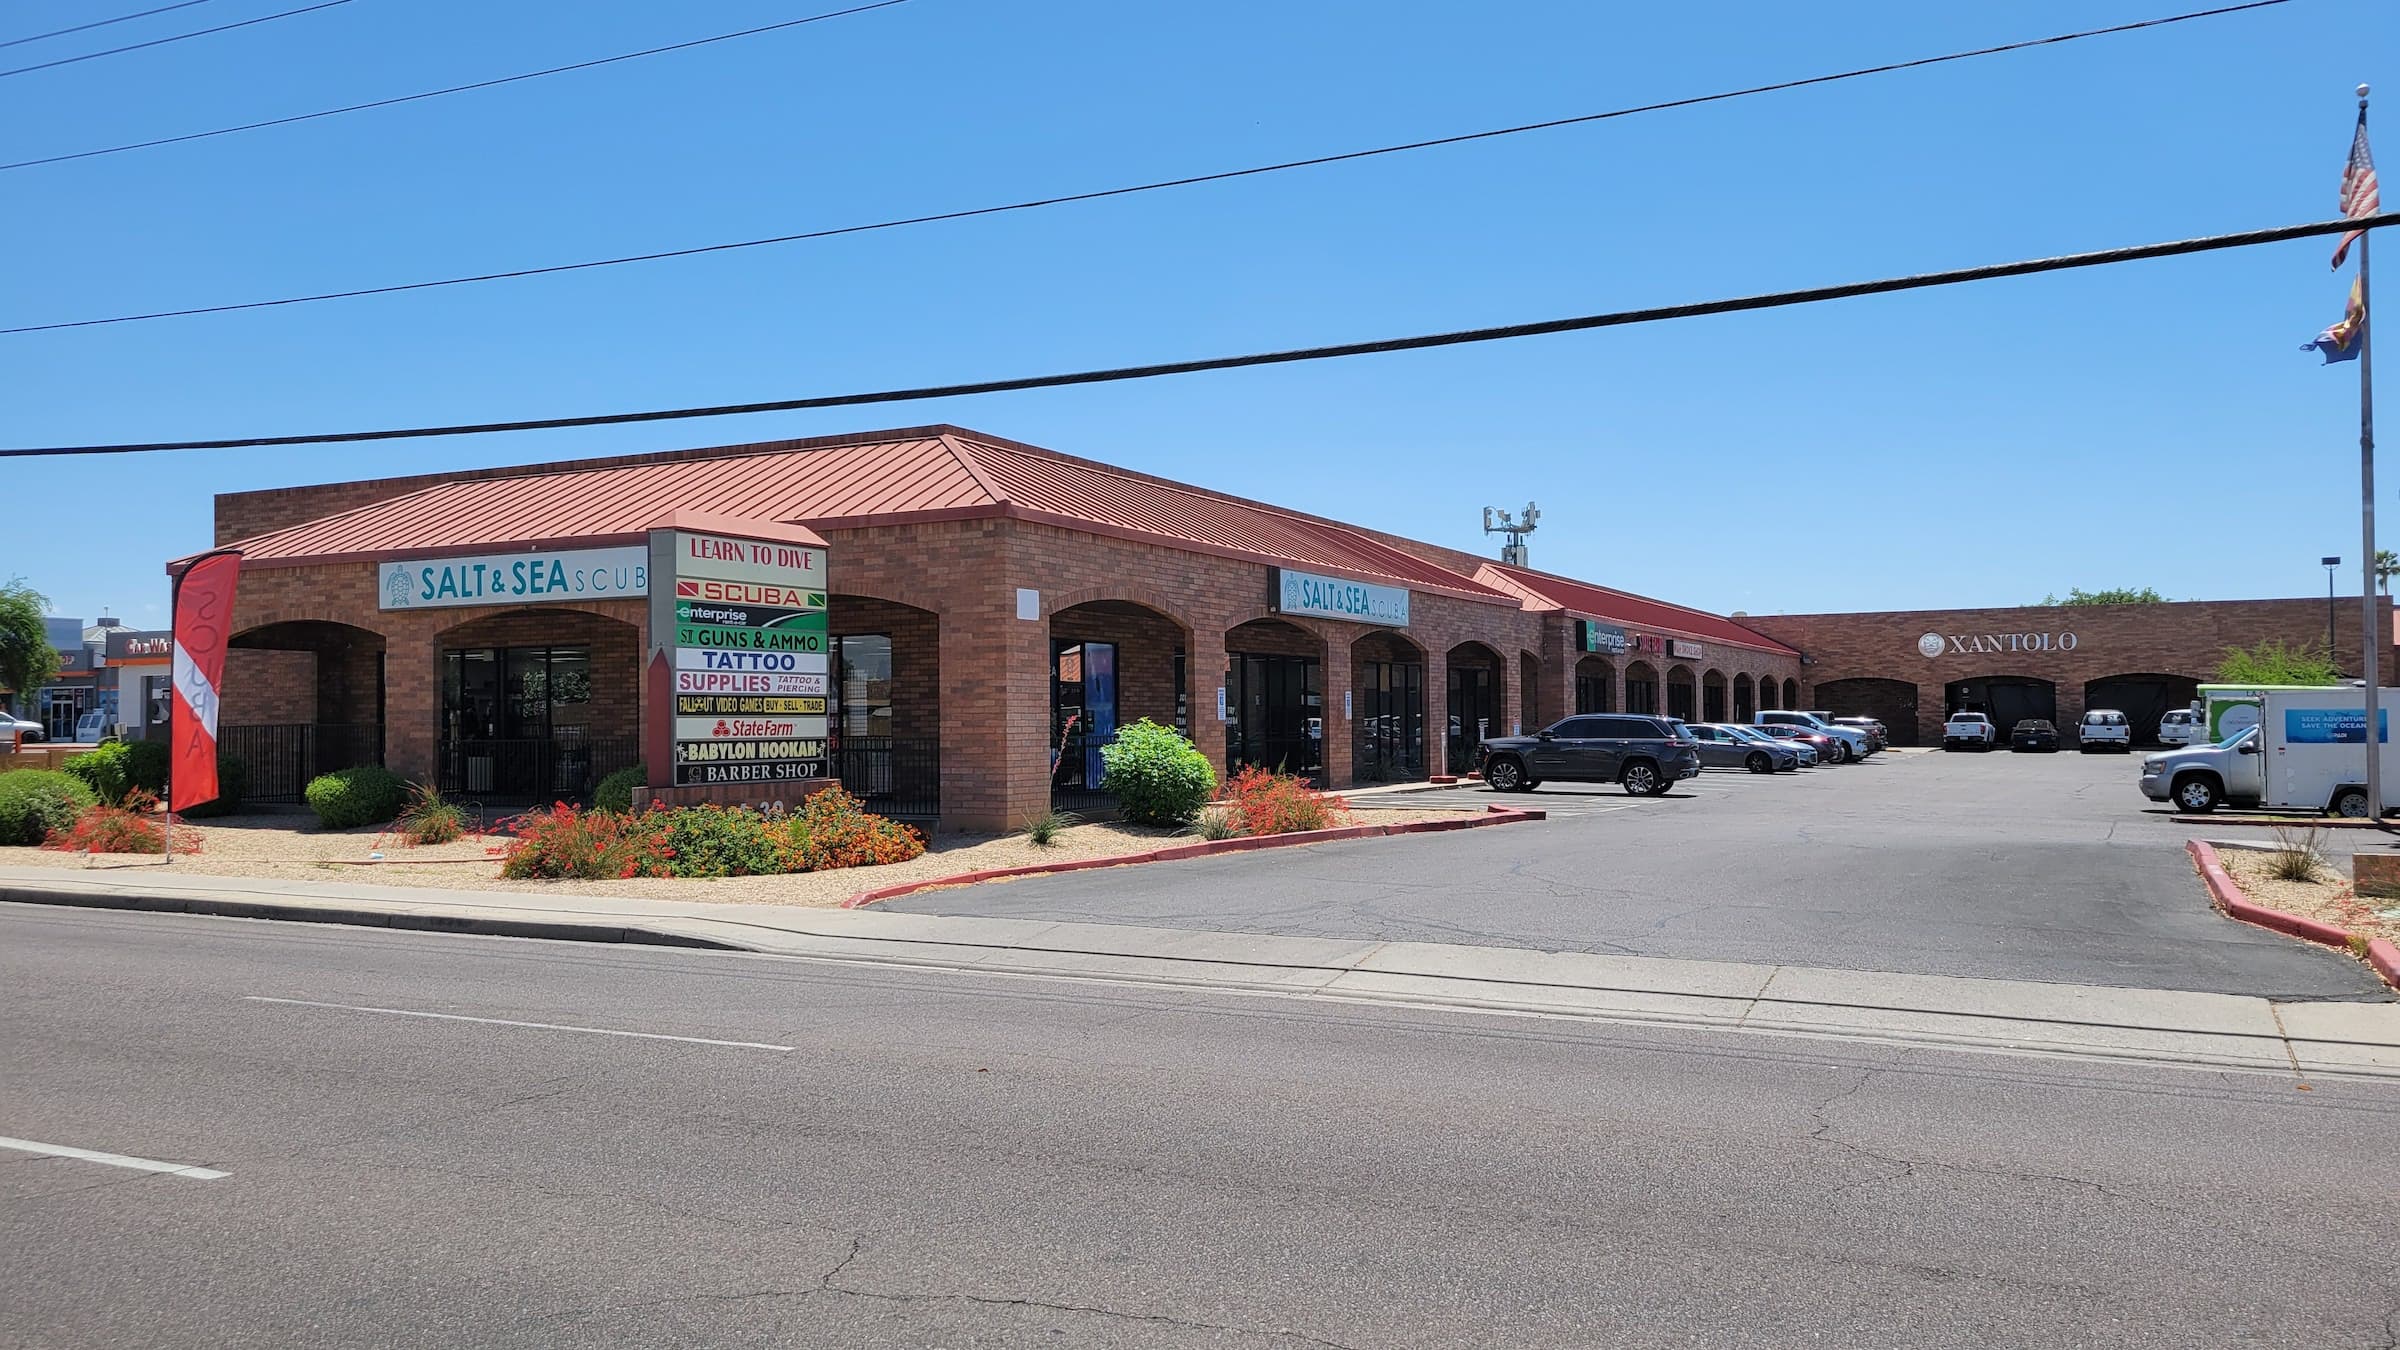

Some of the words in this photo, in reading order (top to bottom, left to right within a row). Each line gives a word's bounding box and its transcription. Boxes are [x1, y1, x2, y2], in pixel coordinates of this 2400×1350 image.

[691, 538, 745, 562] LEARN
[750, 545, 772, 565] TO
[778, 548, 813, 570] DIVE
[421, 564, 487, 600] SALT
[511, 559, 569, 595] SEA
[704, 582, 802, 606] SCUBA
[1303, 579, 1335, 610] SALT
[1346, 586, 1370, 615] SEA
[1371, 599, 1407, 619] SCUBA
[678, 606, 747, 622] enterprise
[698, 630, 748, 647] GUNS
[753, 631, 765, 648] &
[769, 634, 819, 651] AMMO
[1588, 630, 1625, 649] enterprise
[1949, 632, 2078, 653] XANTOLO
[702, 651, 796, 670] TATTOO
[680, 673, 771, 692] SUPPLIES
[777, 676, 812, 684] TATTOO
[777, 685, 820, 693] PIERCING
[715, 697, 738, 713] VIDEO
[740, 697, 763, 713] GAMES
[766, 699, 778, 710] BUY
[784, 700, 799, 711] SELL
[803, 700, 823, 711] TRADE
[688, 742, 756, 760] BABYLON
[759, 741, 817, 758] HOOKAH
[707, 764, 771, 781] BARBER
[775, 763, 818, 778] SHOP
